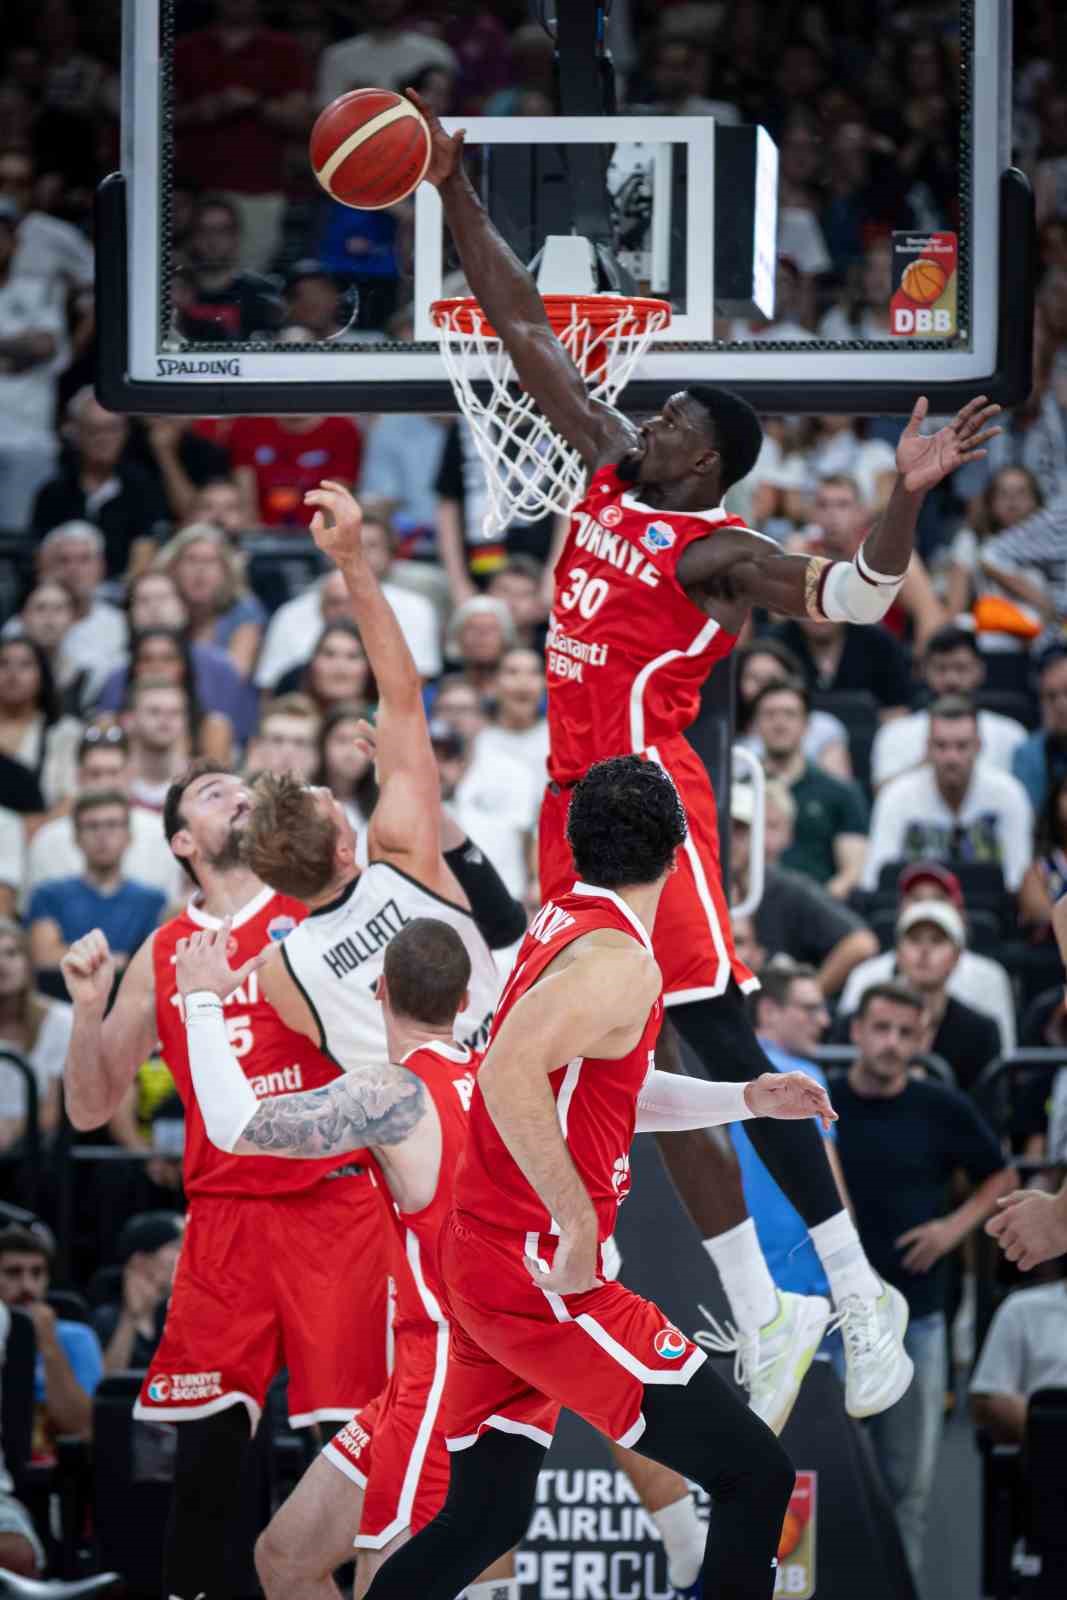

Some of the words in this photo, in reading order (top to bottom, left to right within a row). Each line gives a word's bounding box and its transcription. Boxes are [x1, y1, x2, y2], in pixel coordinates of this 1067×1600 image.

[895, 308, 951, 333] DBB
[156, 358, 241, 377] SPALDING
[561, 568, 609, 620] 30
[322, 898, 412, 980] HOLLATZ
[249, 1063, 303, 1096] anti
[535, 1468, 642, 1504] TURK
[526, 1506, 662, 1541] AIRLIN
[513, 1550, 677, 1600] PERCU
